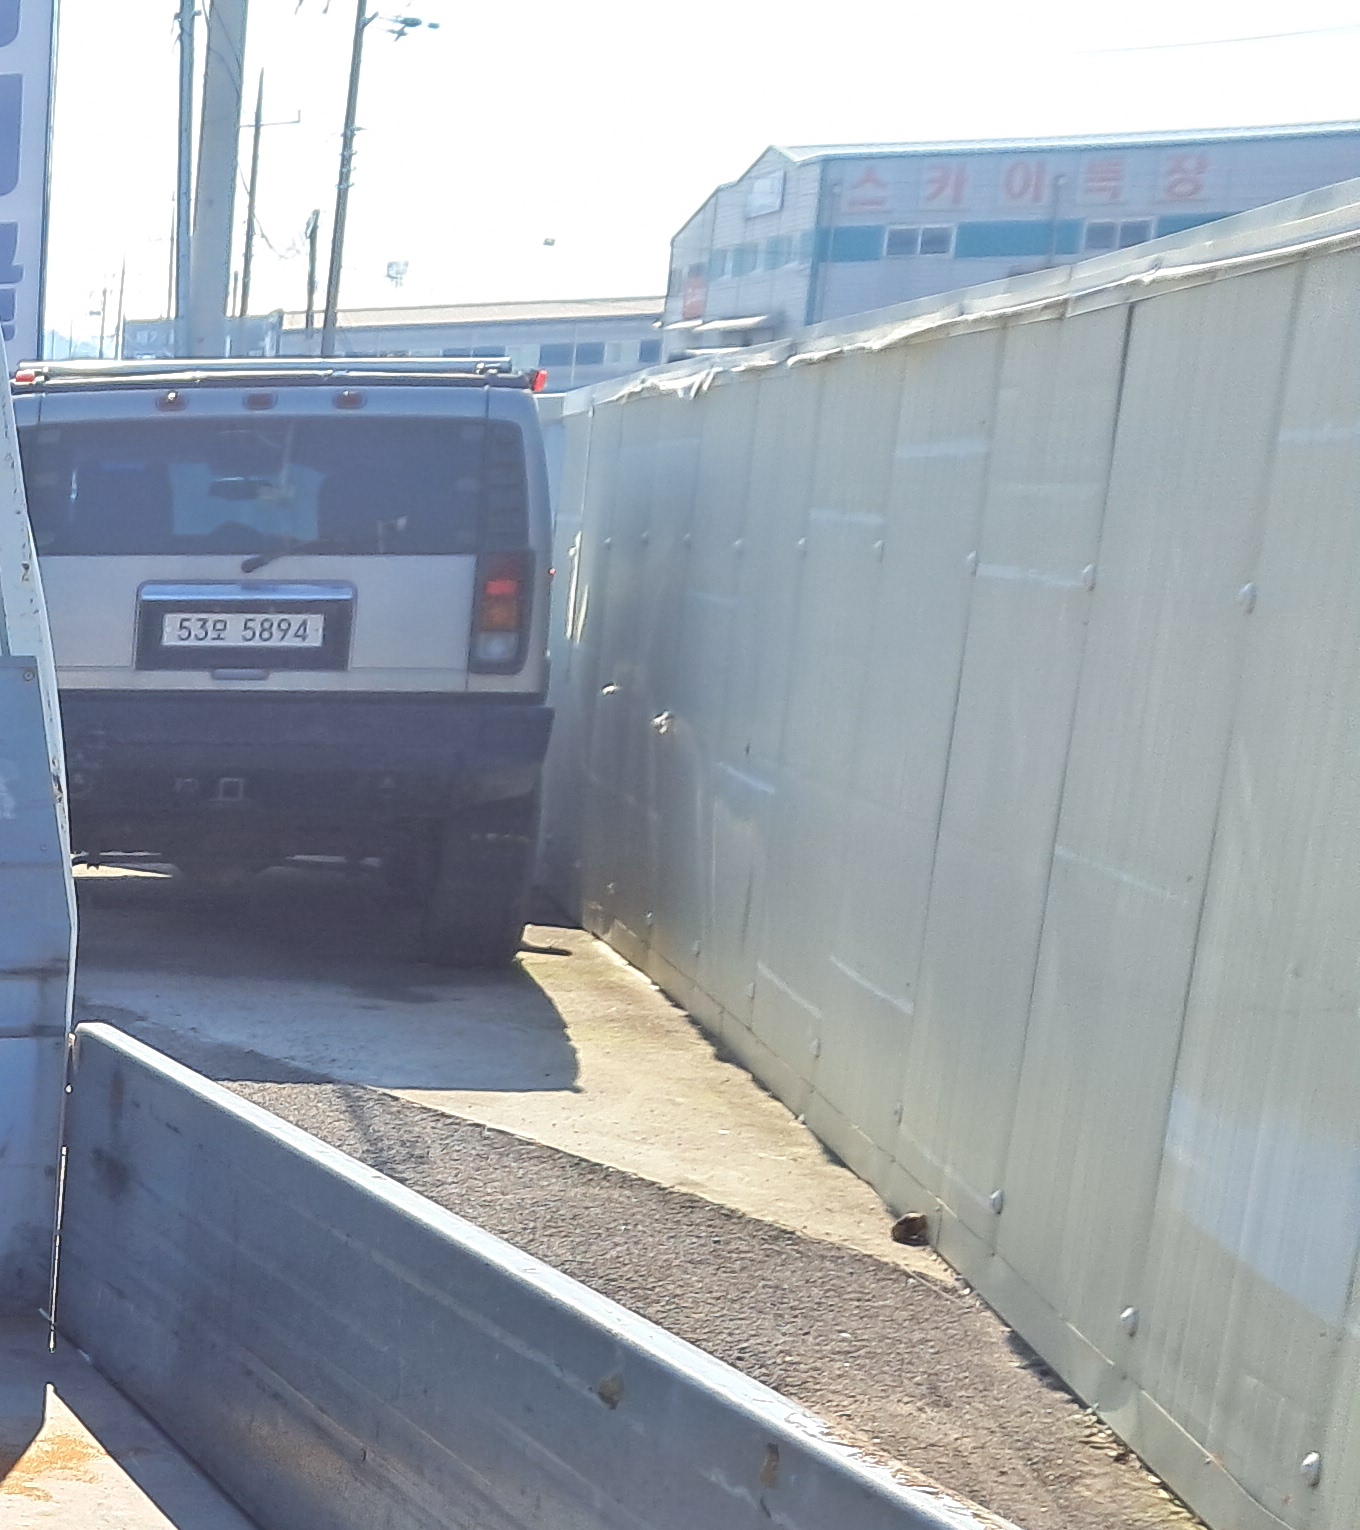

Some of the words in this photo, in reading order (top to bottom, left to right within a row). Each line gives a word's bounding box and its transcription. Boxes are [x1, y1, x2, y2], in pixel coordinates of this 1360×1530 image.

[846, 154, 1211, 211] 스카이특장
[177, 617, 228, 641] 53모
[241, 617, 310, 642] 5894
